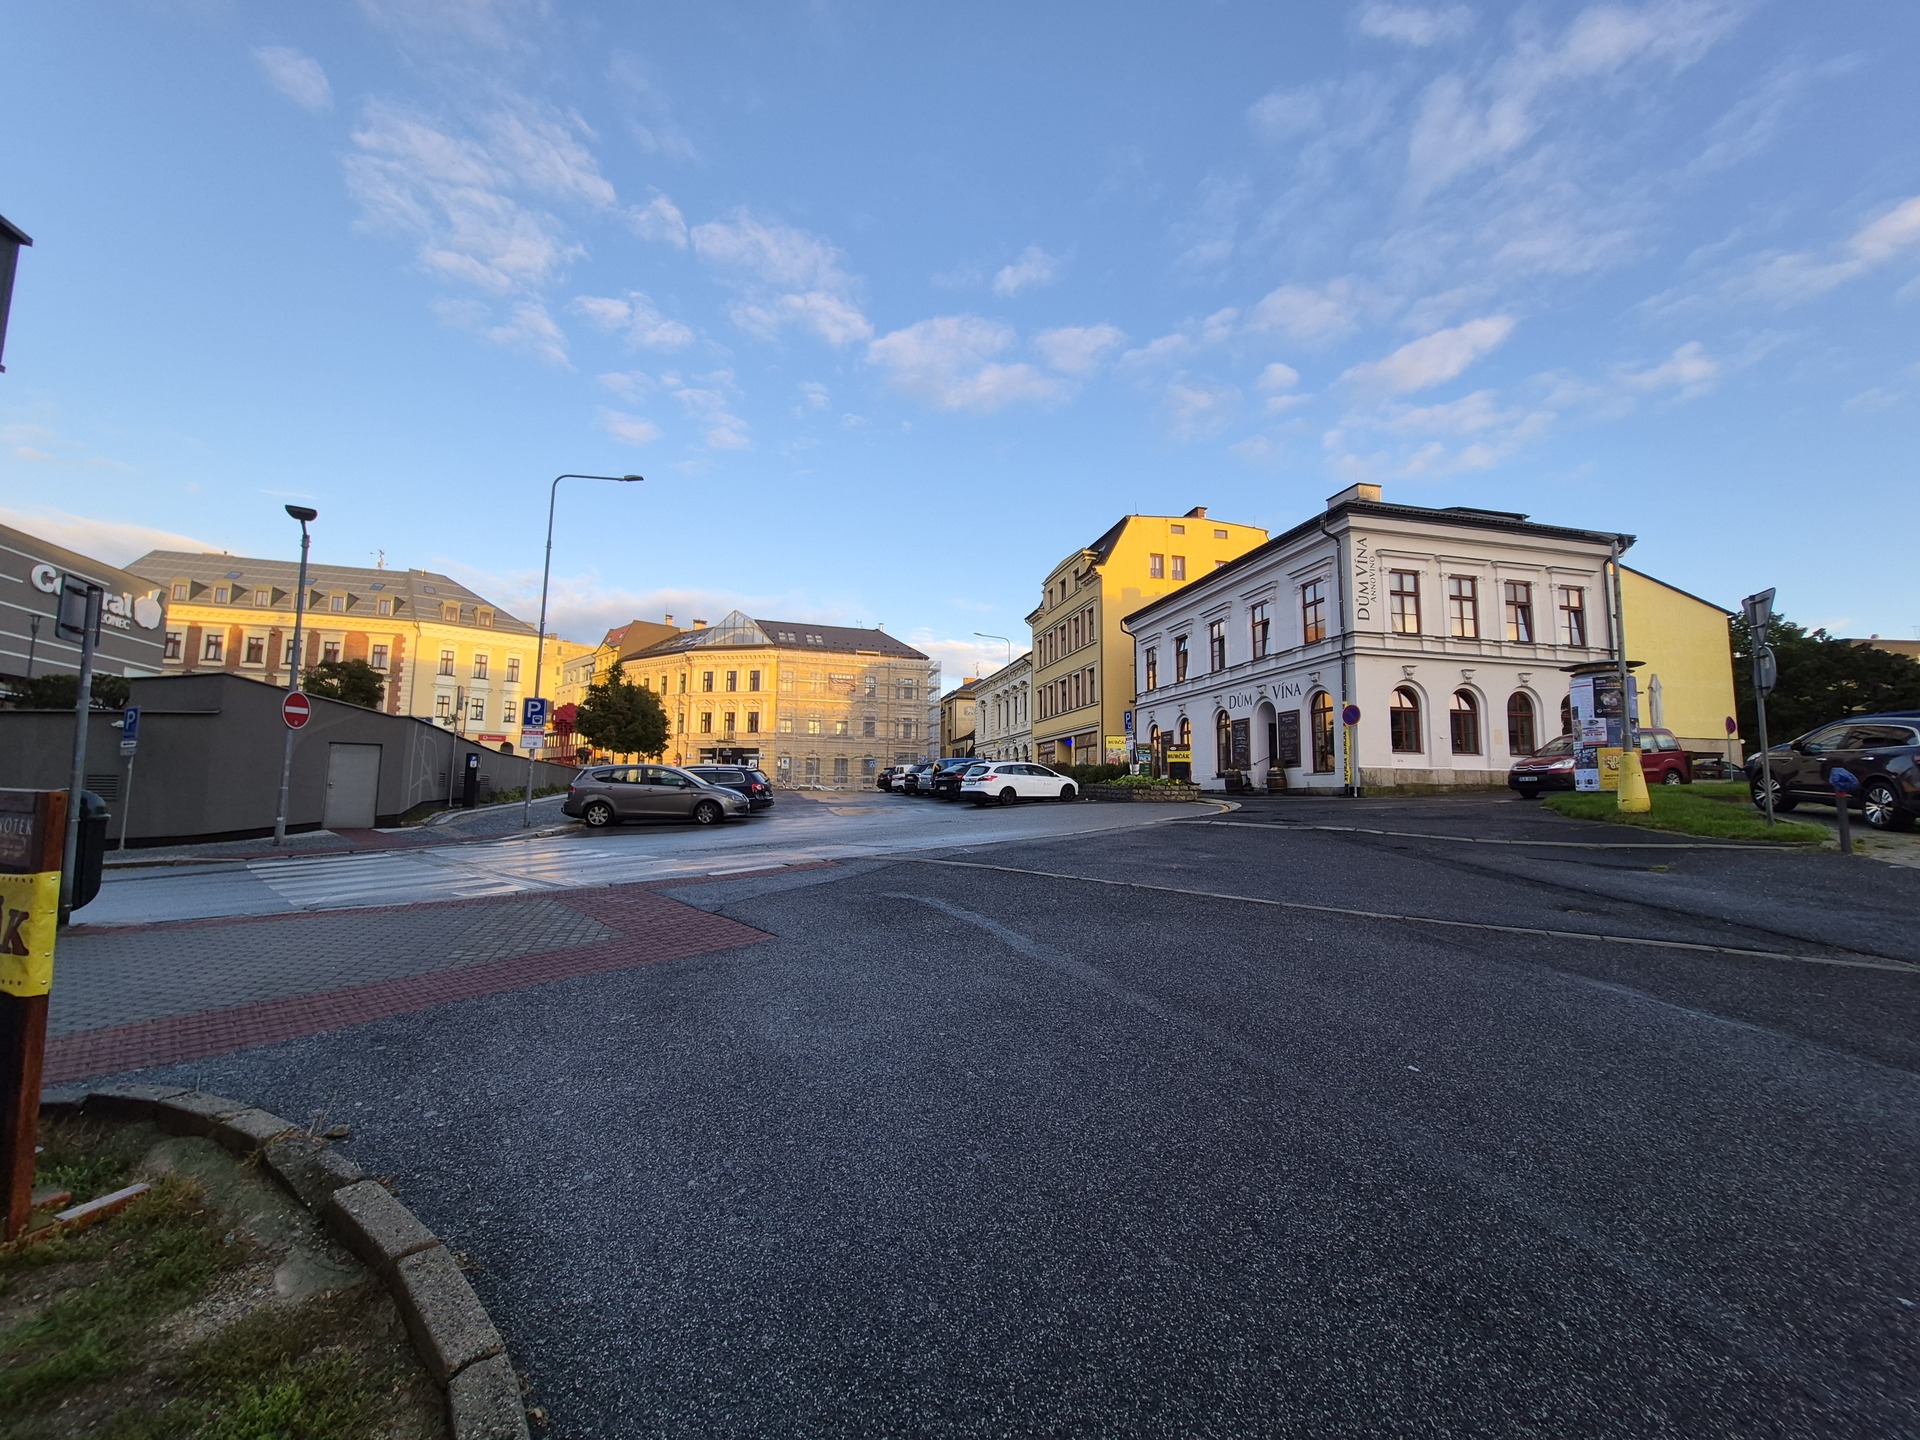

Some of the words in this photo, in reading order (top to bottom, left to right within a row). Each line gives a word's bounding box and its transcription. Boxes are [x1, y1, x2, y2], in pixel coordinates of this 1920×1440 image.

[1354, 537, 1368, 577] VÍNA
[1356, 581, 1371, 621] DŮM
[1229, 692, 1253, 710] DŮM
[1272, 682, 1302, 700] VÍNA
[126, 711, 136, 730] P
[527, 701, 541, 718] P
[1125, 712, 1131, 724] P
